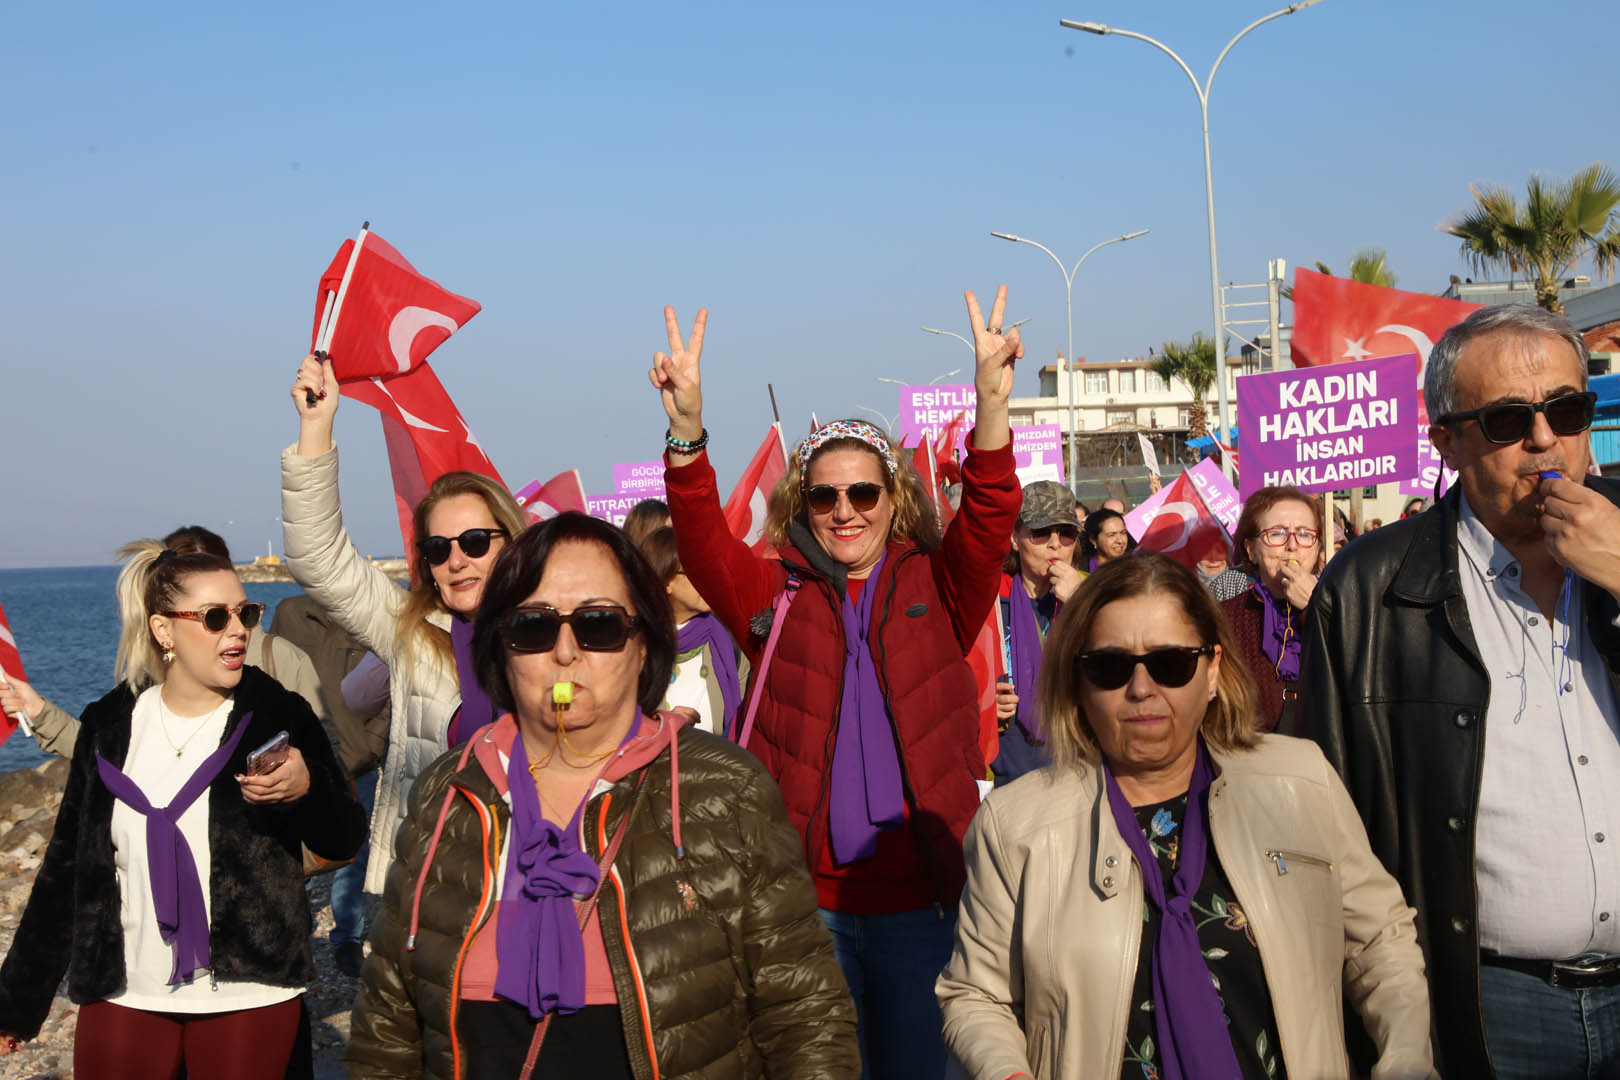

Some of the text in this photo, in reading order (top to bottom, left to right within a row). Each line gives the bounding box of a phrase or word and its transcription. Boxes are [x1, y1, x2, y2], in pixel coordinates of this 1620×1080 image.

[1280, 370, 1377, 409] KADIN
[1259, 398, 1398, 442] HAKLARI
[1296, 435, 1363, 462] İNSAN
[1264, 455, 1396, 488] HAKLARIDIR
